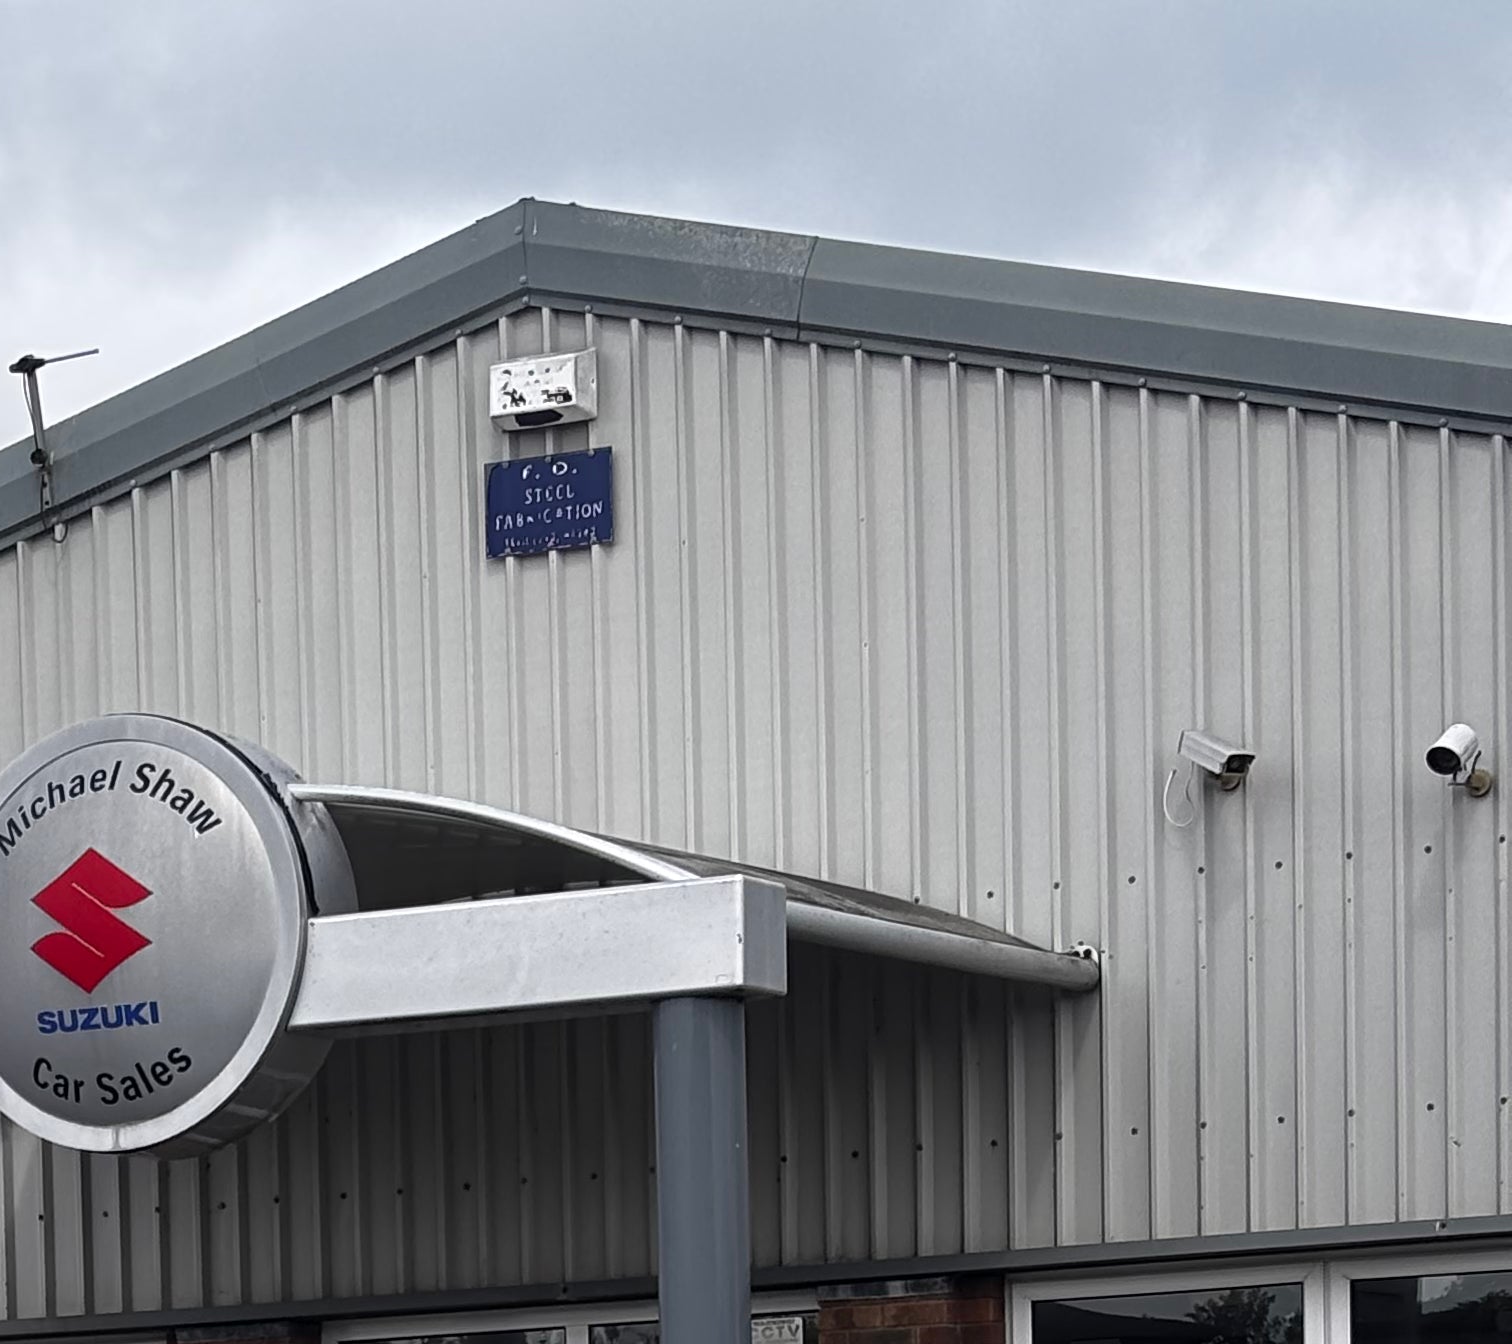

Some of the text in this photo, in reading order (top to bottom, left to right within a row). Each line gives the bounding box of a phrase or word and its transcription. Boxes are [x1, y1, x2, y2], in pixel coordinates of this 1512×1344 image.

[129, 763, 222, 835] Shaw
[38, 1001, 159, 1034] SUZUKI
[33, 1047, 192, 1105] Car Sales
